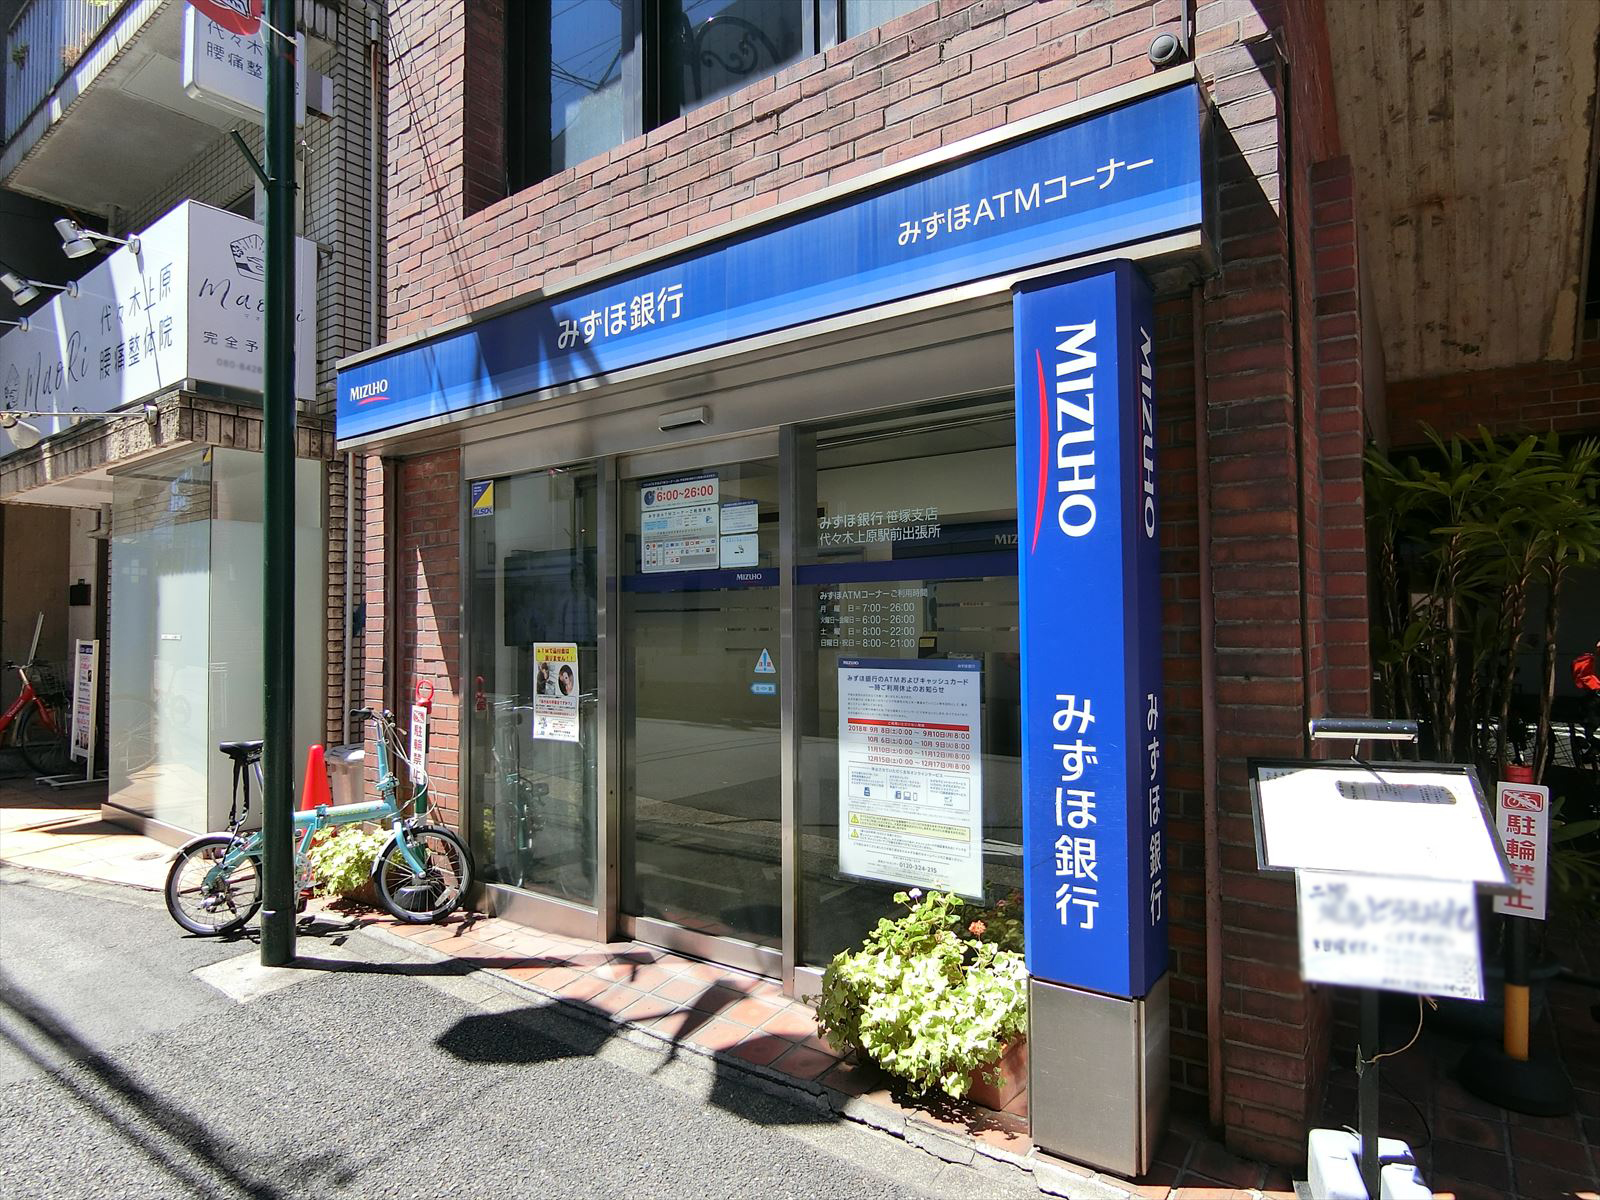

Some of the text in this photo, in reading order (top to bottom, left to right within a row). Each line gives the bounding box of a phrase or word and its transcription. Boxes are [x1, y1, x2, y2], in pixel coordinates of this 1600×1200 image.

[897, 157, 1154, 246] みずほATMコーナー
[101, 262, 173, 335] 代々木上原
[557, 283, 684, 350] みずほ銀行
[99, 316, 174, 381] 腰痛整体院
[349, 378, 389, 402] MIZUHO
[1055, 319, 1097, 538] MIZUHO
[1140, 326, 1155, 539] MIZUHO
[819, 506, 939, 530] みずほ銀行 笹塚支店
[819, 524, 941, 546] 代々木上原駅前出張所
[736, 573, 762, 581] MIZUHO
[1052, 694, 1099, 930] みずほ銀行
[1147, 693, 1162, 926] みずほ銀行
[1504, 814, 1537, 911] 駐輪禁止
